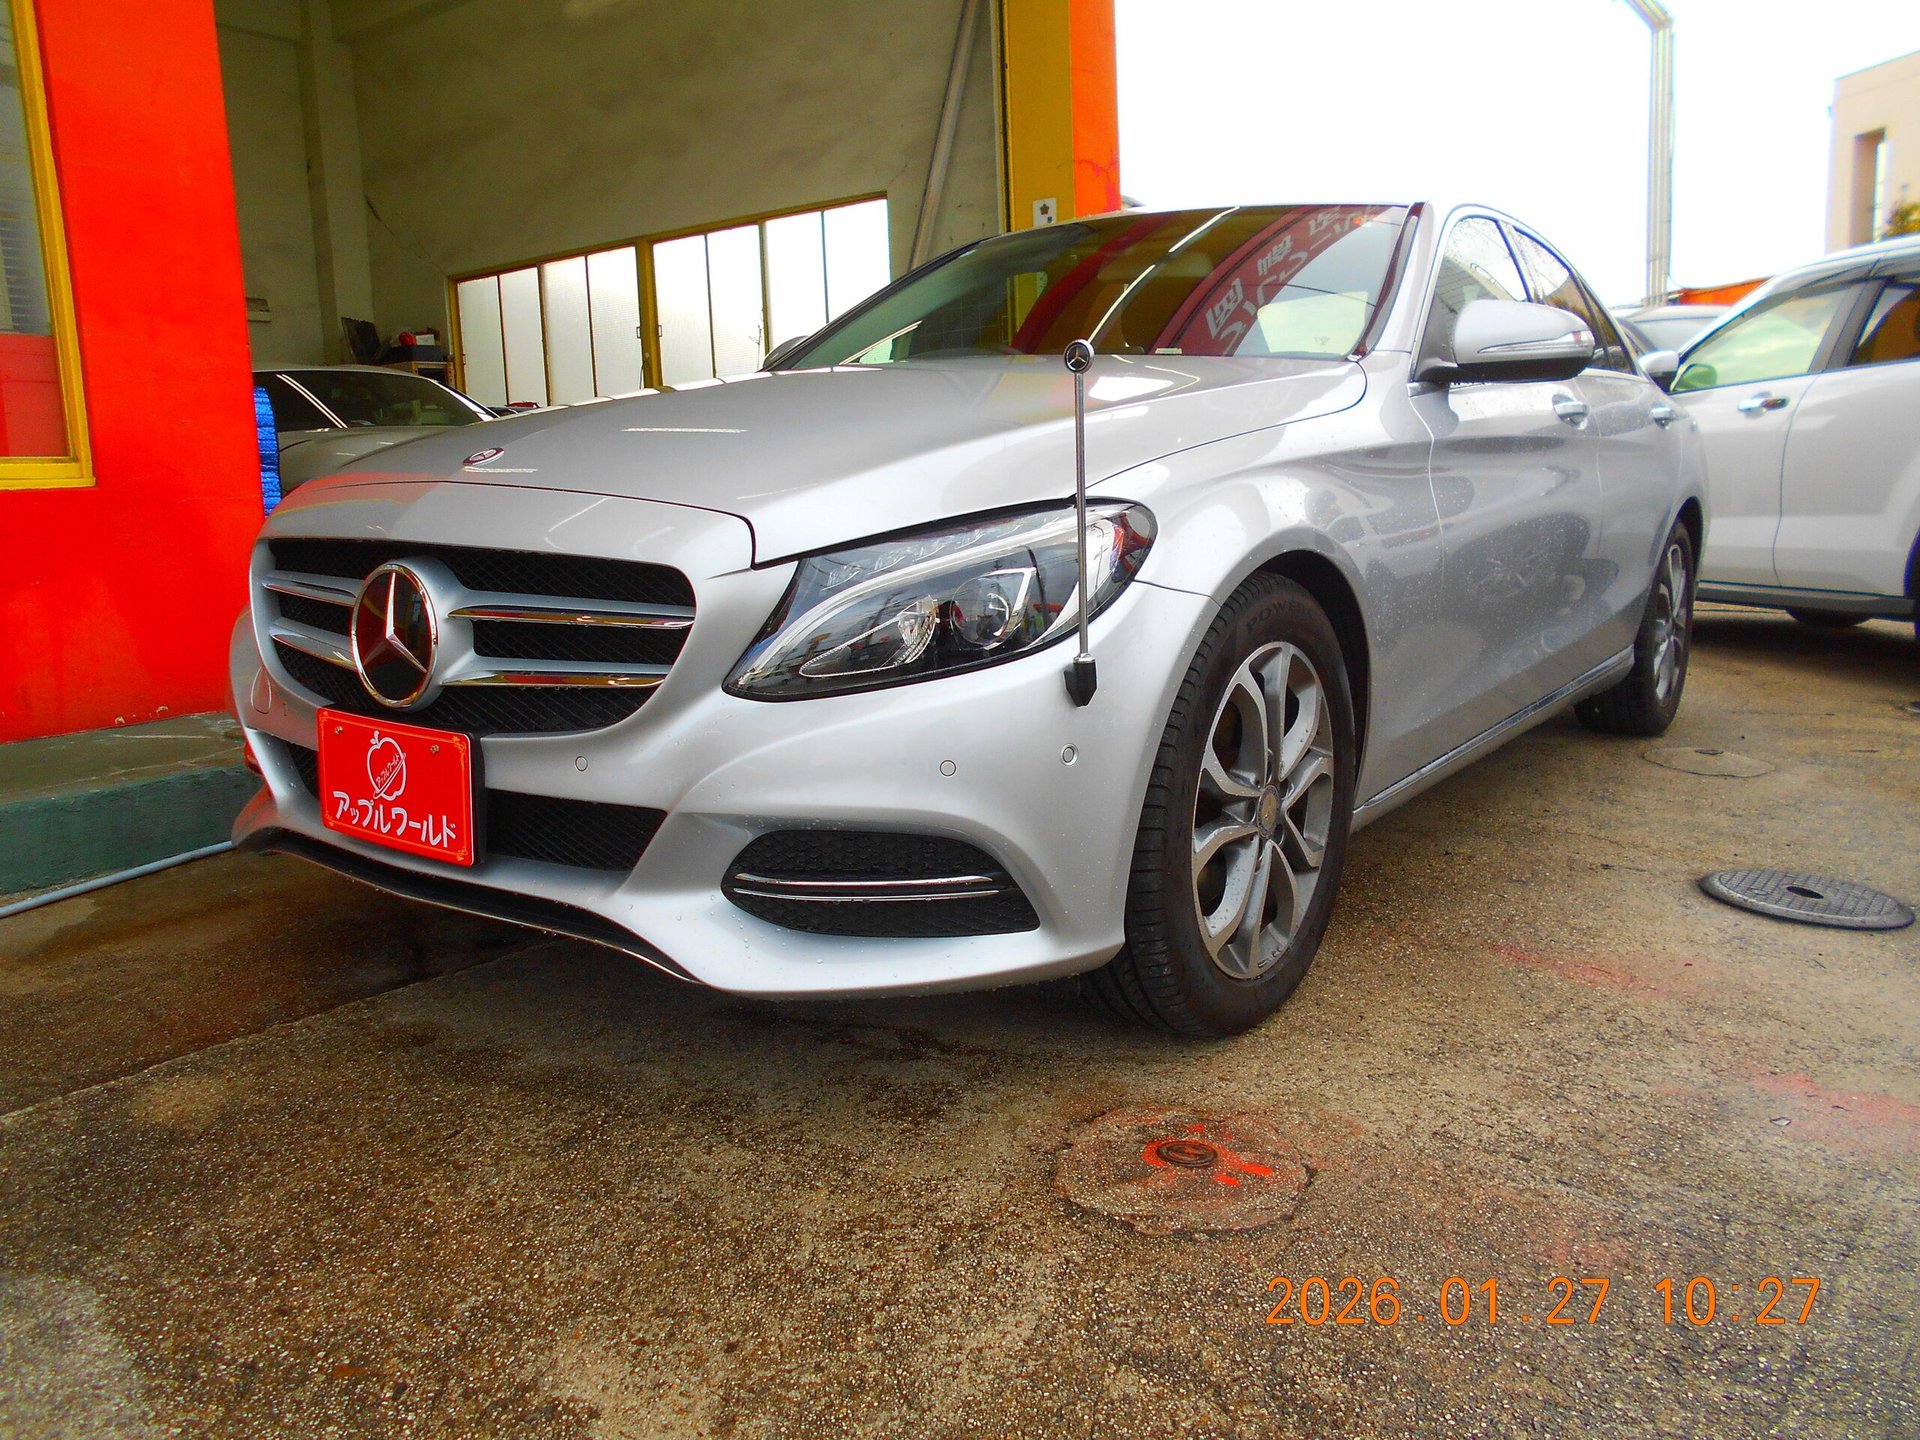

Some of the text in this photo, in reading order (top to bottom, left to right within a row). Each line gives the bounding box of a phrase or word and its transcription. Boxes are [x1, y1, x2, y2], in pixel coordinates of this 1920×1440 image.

[332, 790, 457, 848] アップルワールド
